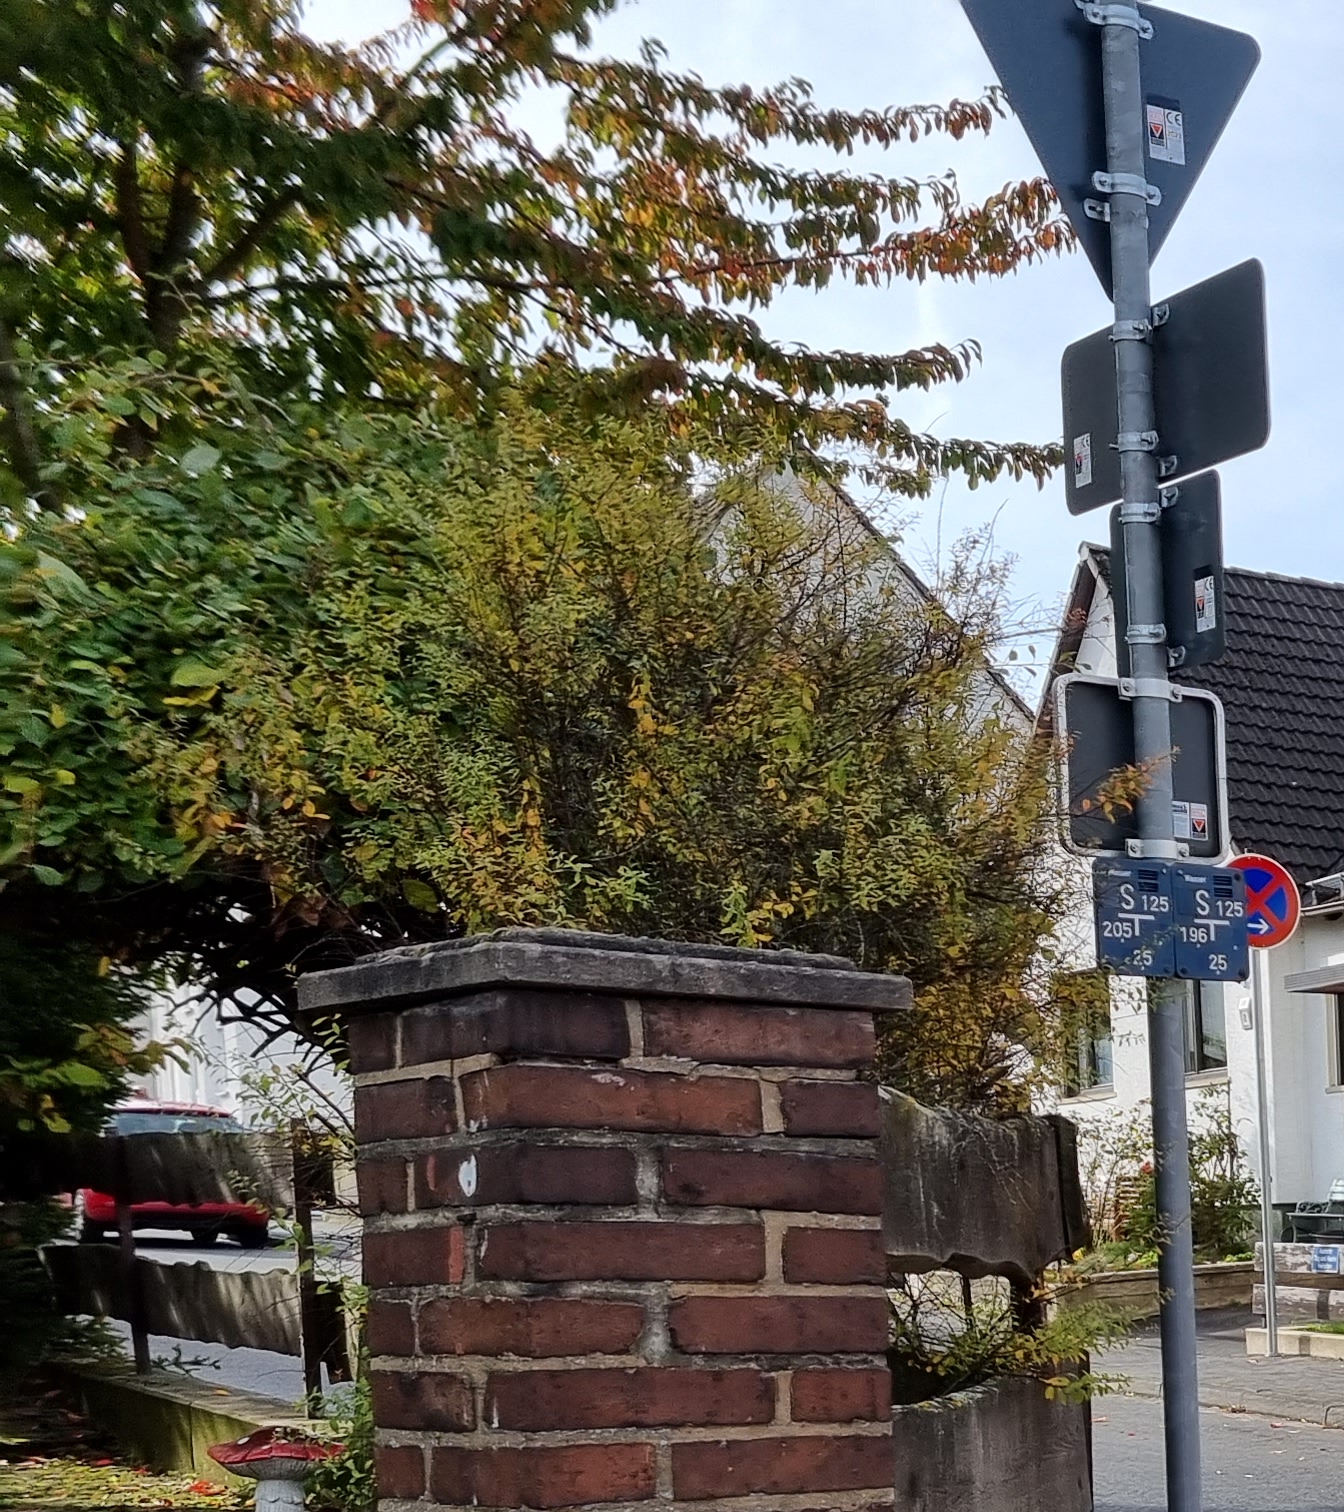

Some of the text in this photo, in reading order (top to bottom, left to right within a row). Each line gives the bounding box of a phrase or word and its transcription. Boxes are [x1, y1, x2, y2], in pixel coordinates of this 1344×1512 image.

[1119, 883, 1169, 912] S 125
[1195, 889, 1244, 918] S 125
